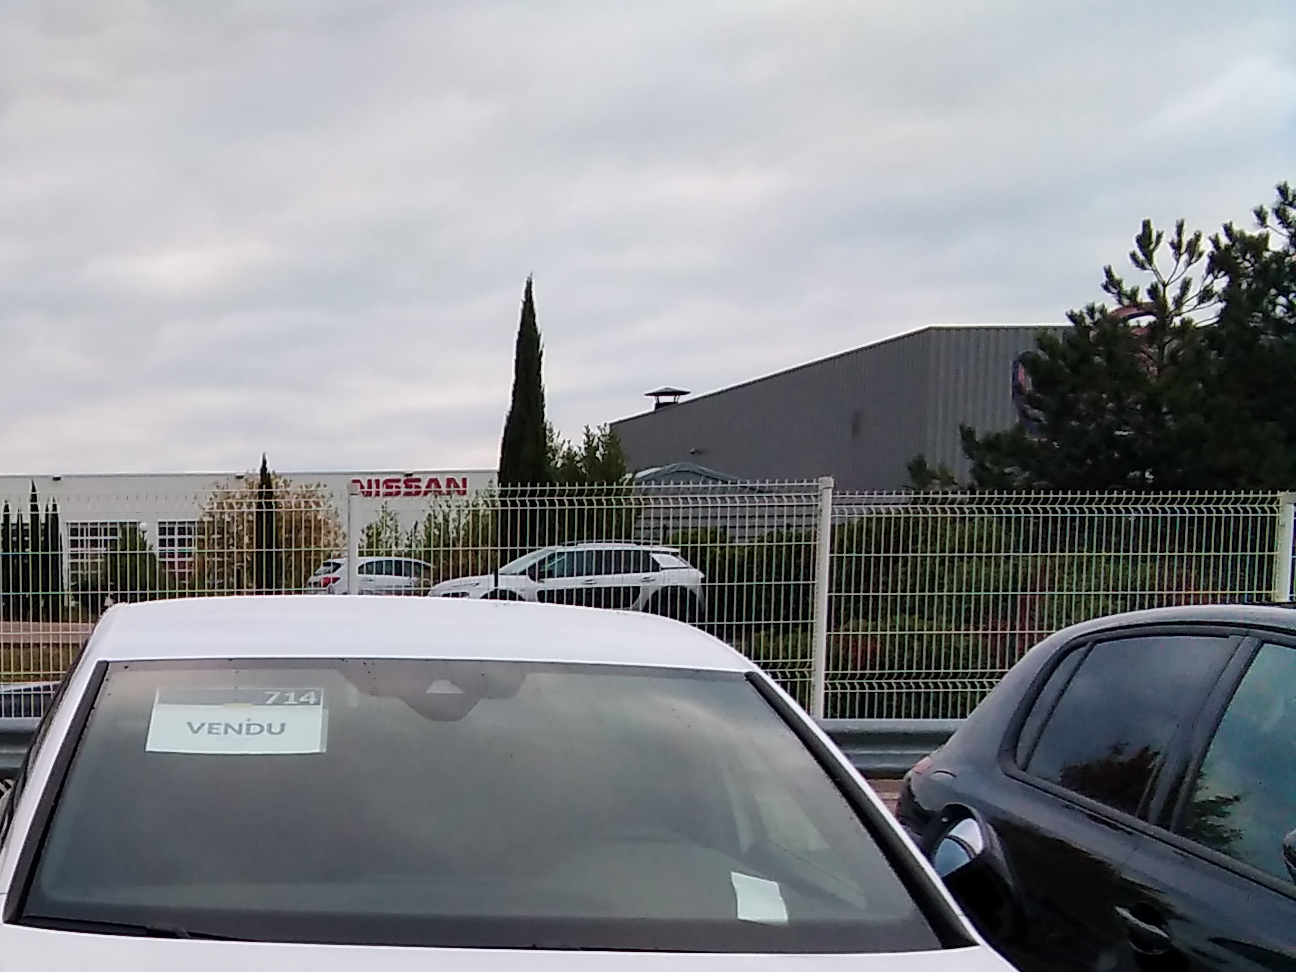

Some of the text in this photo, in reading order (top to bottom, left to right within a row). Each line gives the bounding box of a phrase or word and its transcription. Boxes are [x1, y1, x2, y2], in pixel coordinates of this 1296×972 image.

[350, 477, 467, 497] NISSAN
[264, 691, 318, 705] 714
[187, 721, 286, 736] VENDU
